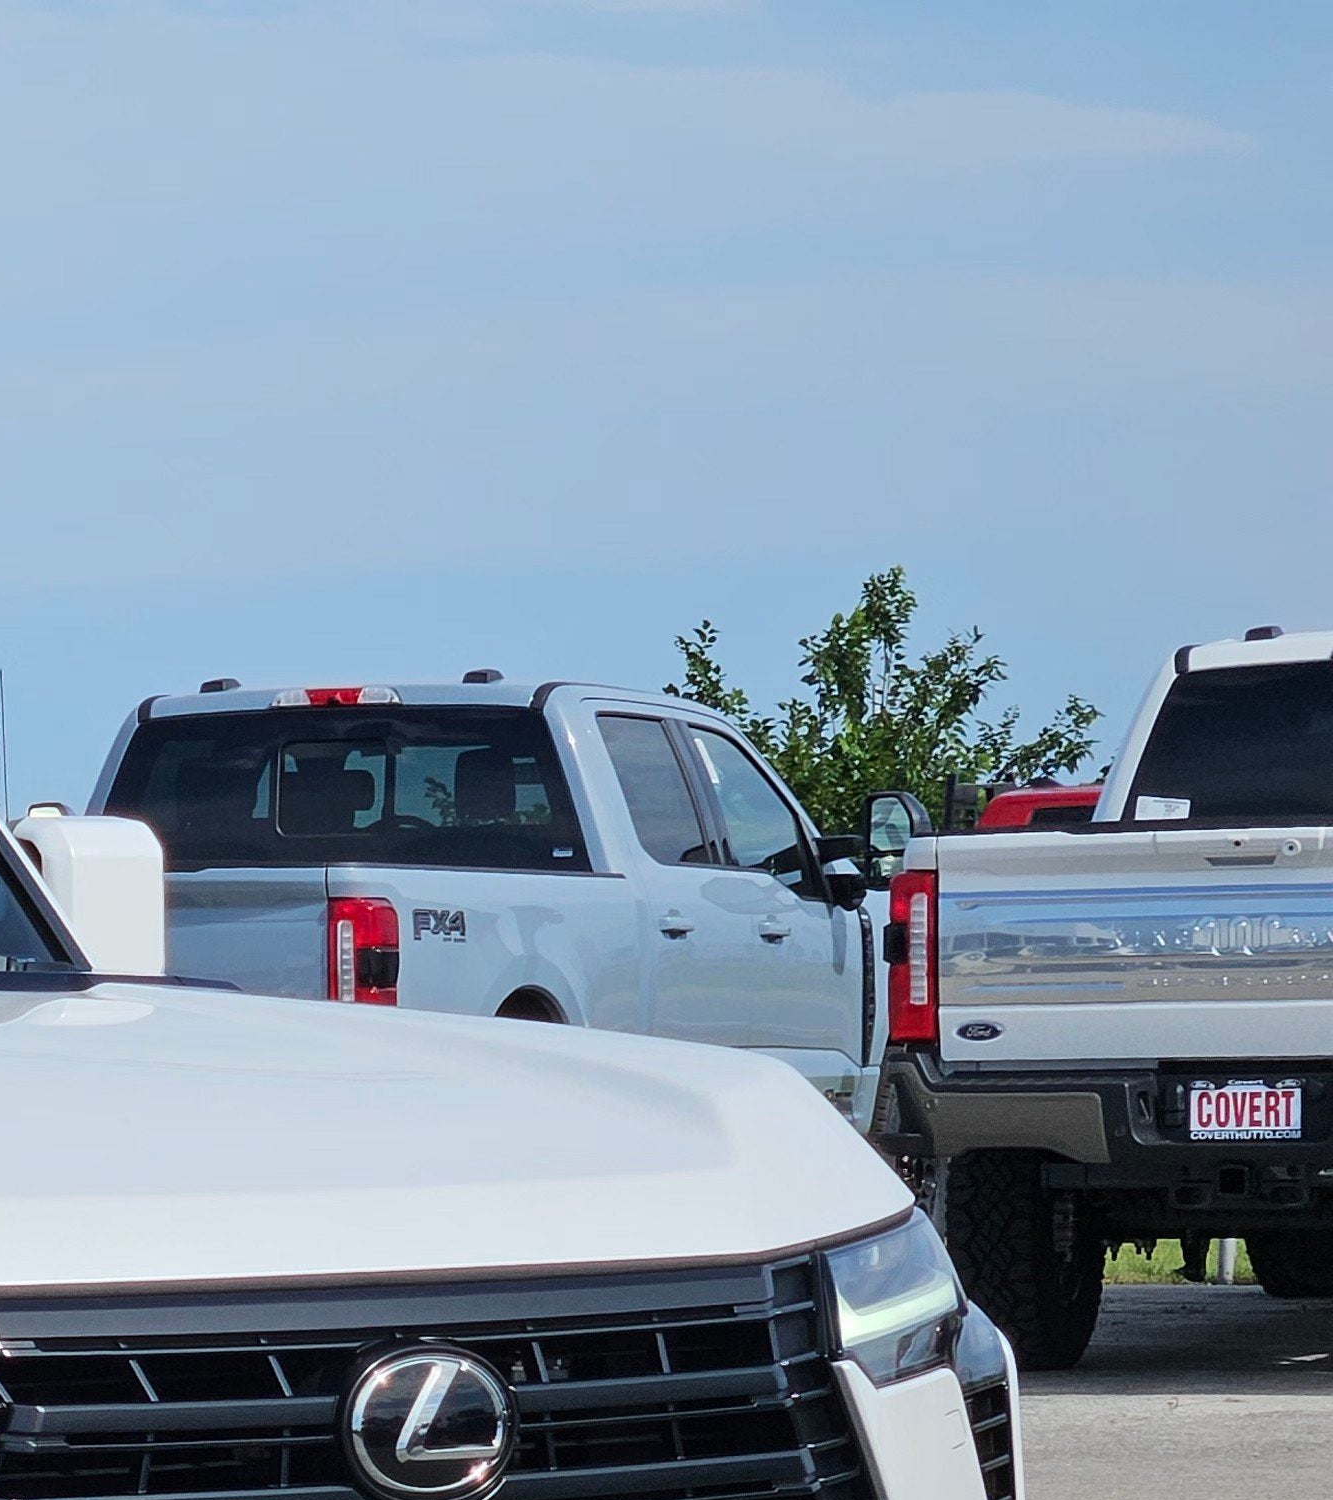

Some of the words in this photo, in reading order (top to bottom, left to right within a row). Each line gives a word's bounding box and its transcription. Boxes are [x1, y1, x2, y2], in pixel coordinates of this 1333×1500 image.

[413, 908, 466, 941] FX4
[964, 1025, 994, 1039] Ford
[1197, 1090, 1295, 1128] COVERT
[1189, 1130, 1302, 1140] COVERTHUTTO.COM
